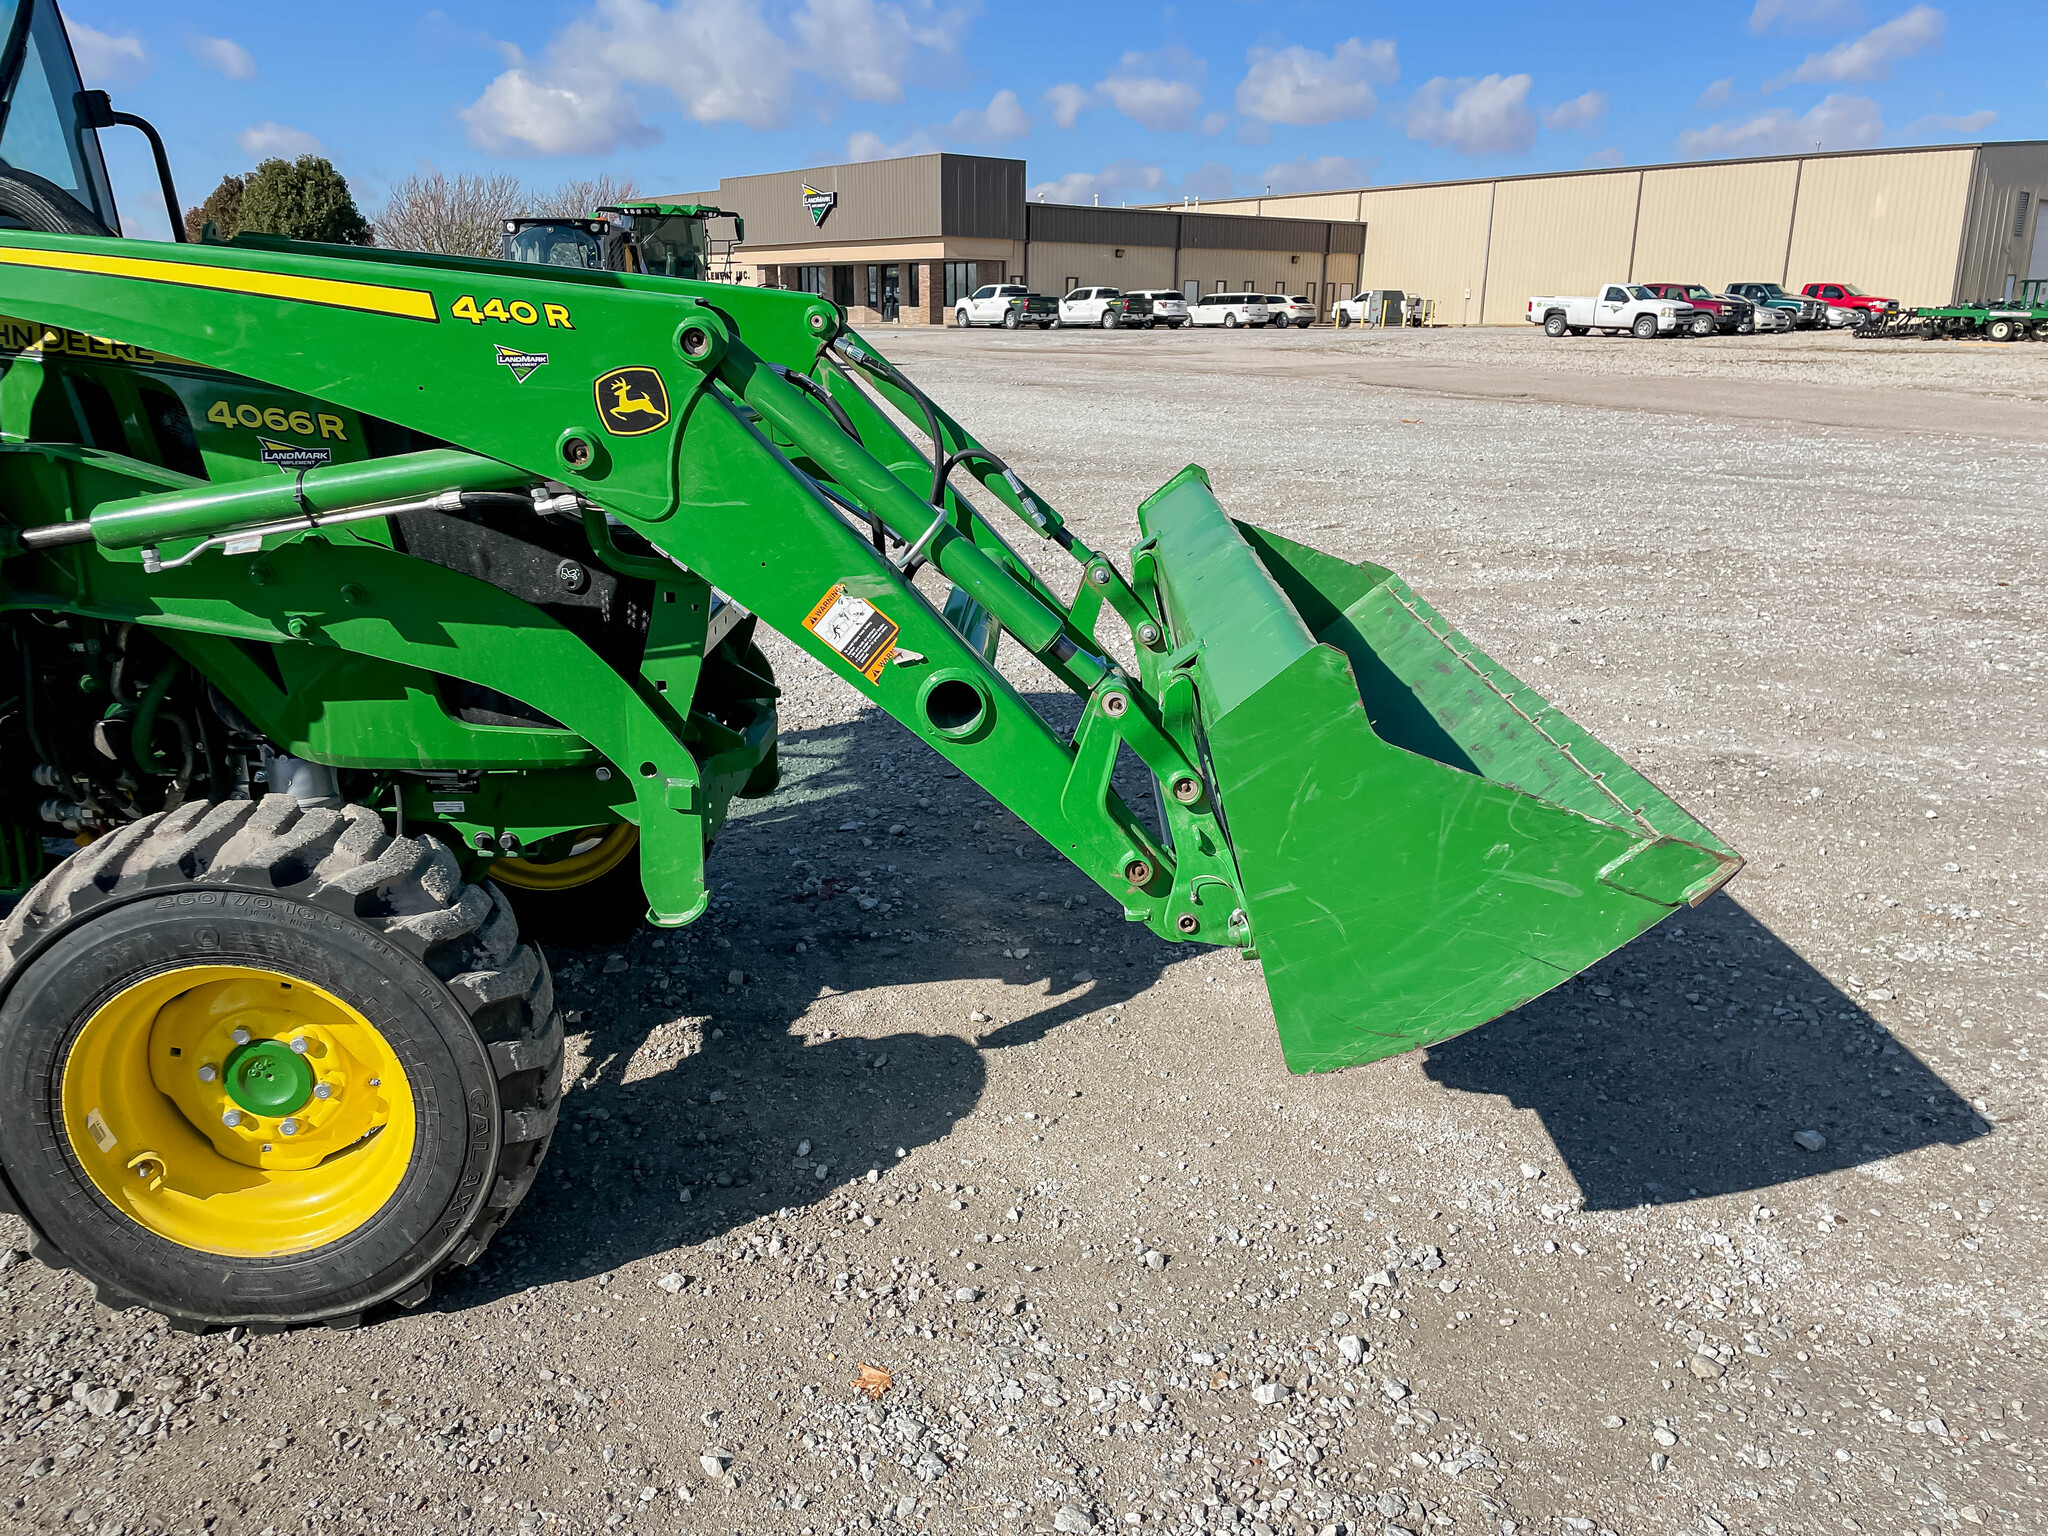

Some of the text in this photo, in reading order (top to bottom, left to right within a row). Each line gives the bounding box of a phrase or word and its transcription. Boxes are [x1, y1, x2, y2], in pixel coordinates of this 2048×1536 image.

[450, 294, 577, 331] 440 R
[207, 400, 349, 441] 4066 R
